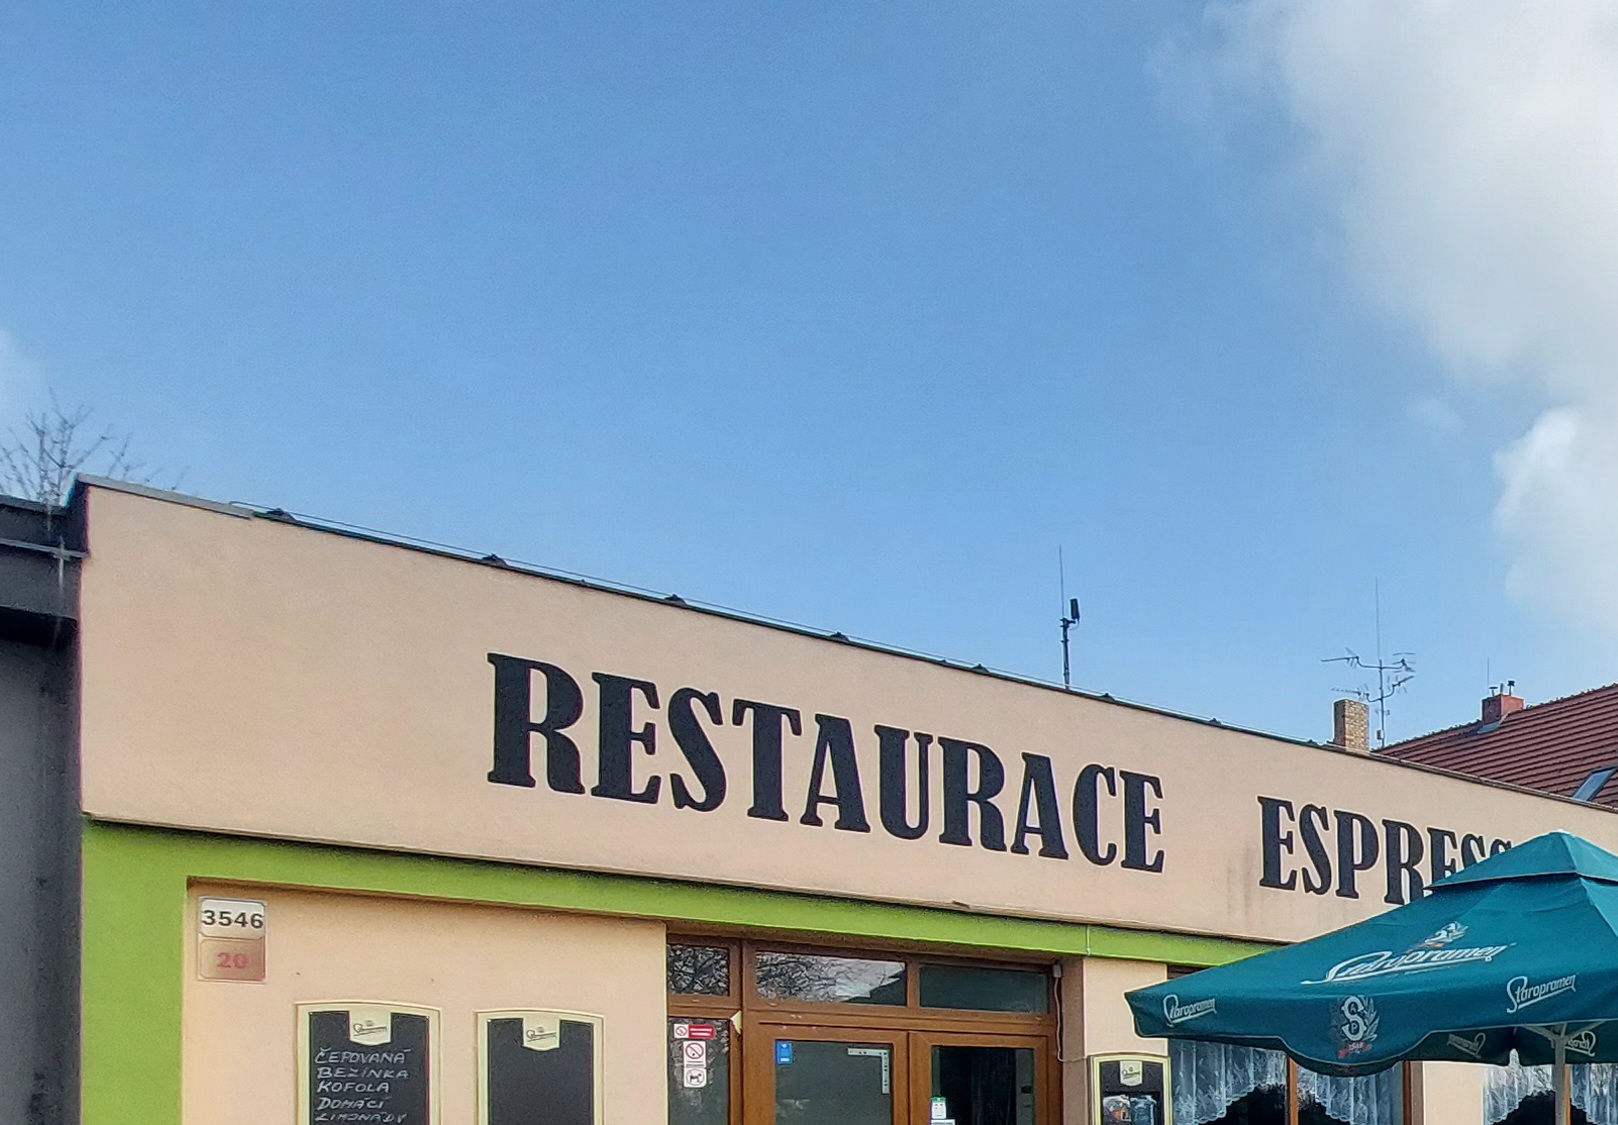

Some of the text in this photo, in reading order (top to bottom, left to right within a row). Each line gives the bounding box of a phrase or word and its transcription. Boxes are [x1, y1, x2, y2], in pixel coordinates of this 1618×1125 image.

[487, 652, 1164, 873] RESTAURACE
[201, 909, 265, 930] 3546
[217, 952, 249, 970] 20
[1506, 974, 1577, 1014] Staropramen
[316, 1081, 390, 1093] KOFOLA
